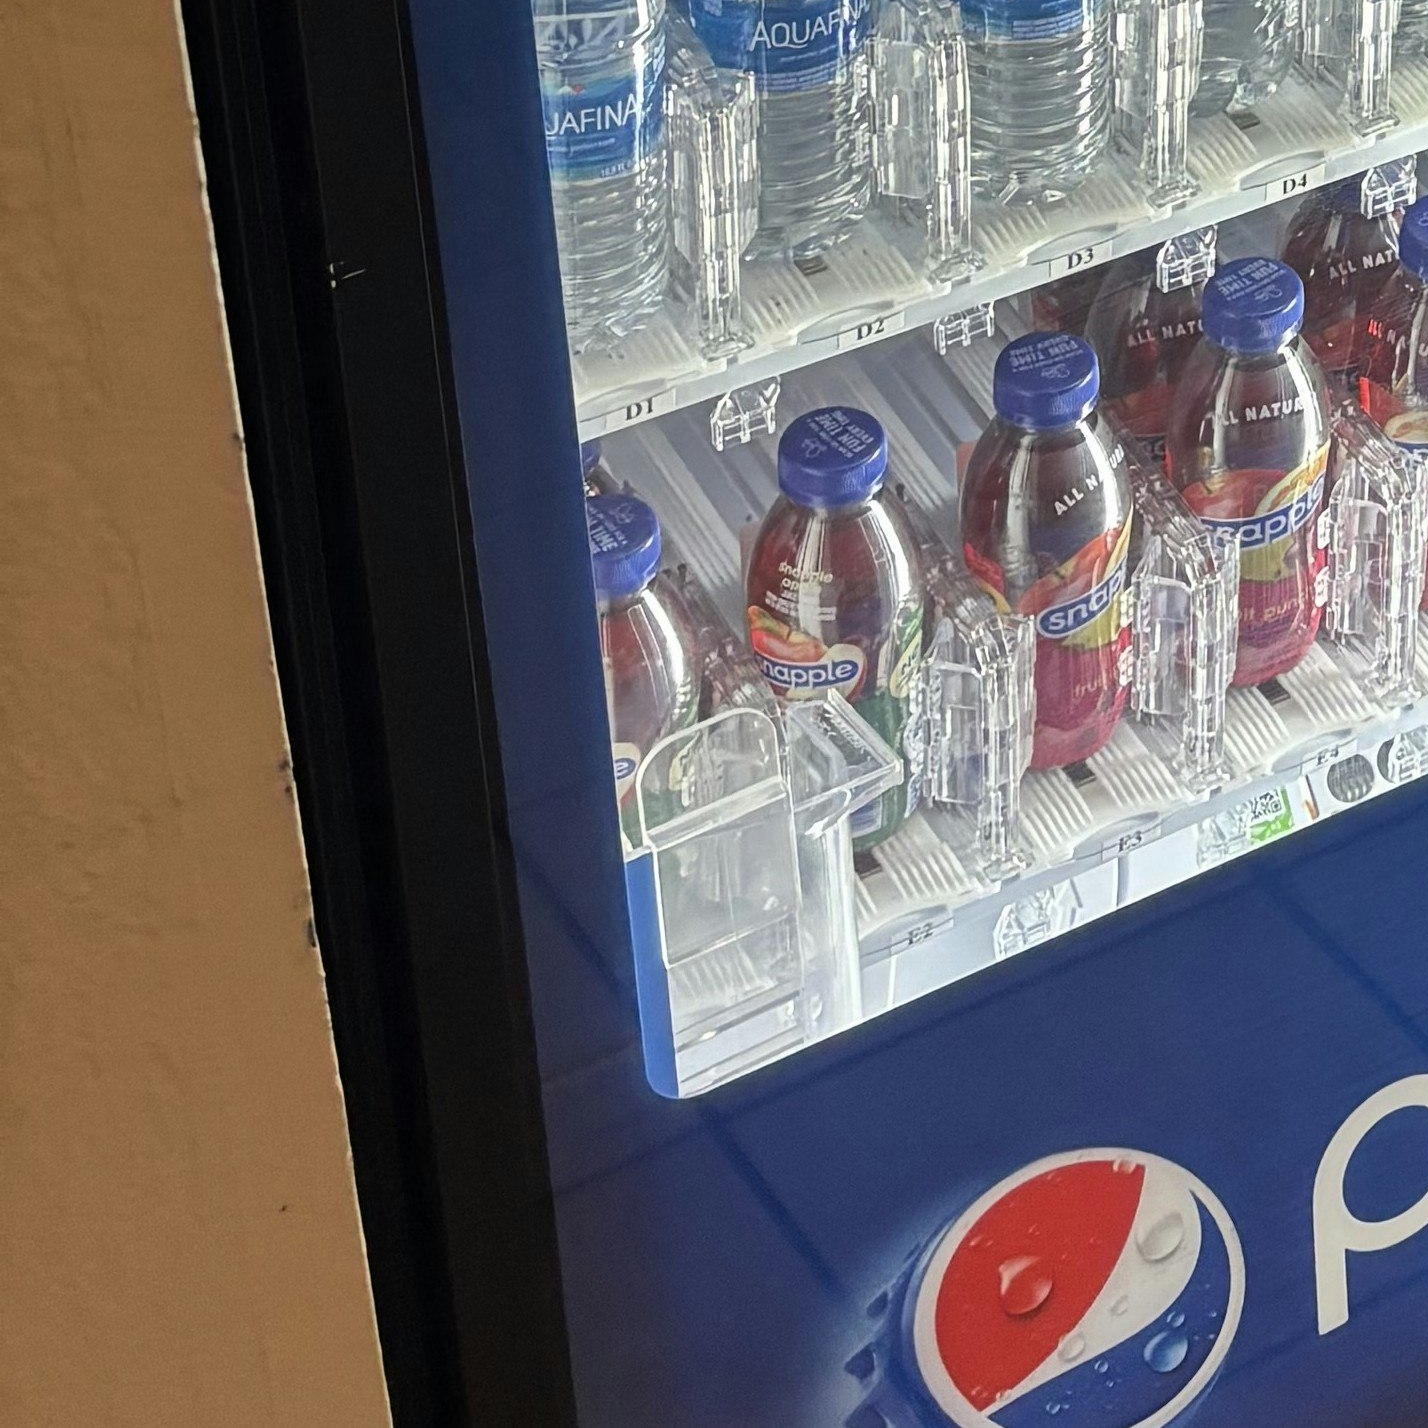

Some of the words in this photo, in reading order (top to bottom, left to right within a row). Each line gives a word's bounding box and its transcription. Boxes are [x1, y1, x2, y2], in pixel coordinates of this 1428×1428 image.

[1282, 174, 1308, 193] D4
[1066, 248, 1094, 268] D3
[1329, 261, 1356, 281] ALL
[856, 318, 885, 339] D2
[1127, 328, 1156, 348] ALL
[625, 398, 655, 421] D1
[1055, 487, 1084, 516] ALL
[1316, 748, 1340, 766] E4
[1118, 831, 1143, 852] E3
[907, 924, 934, 944] E2
